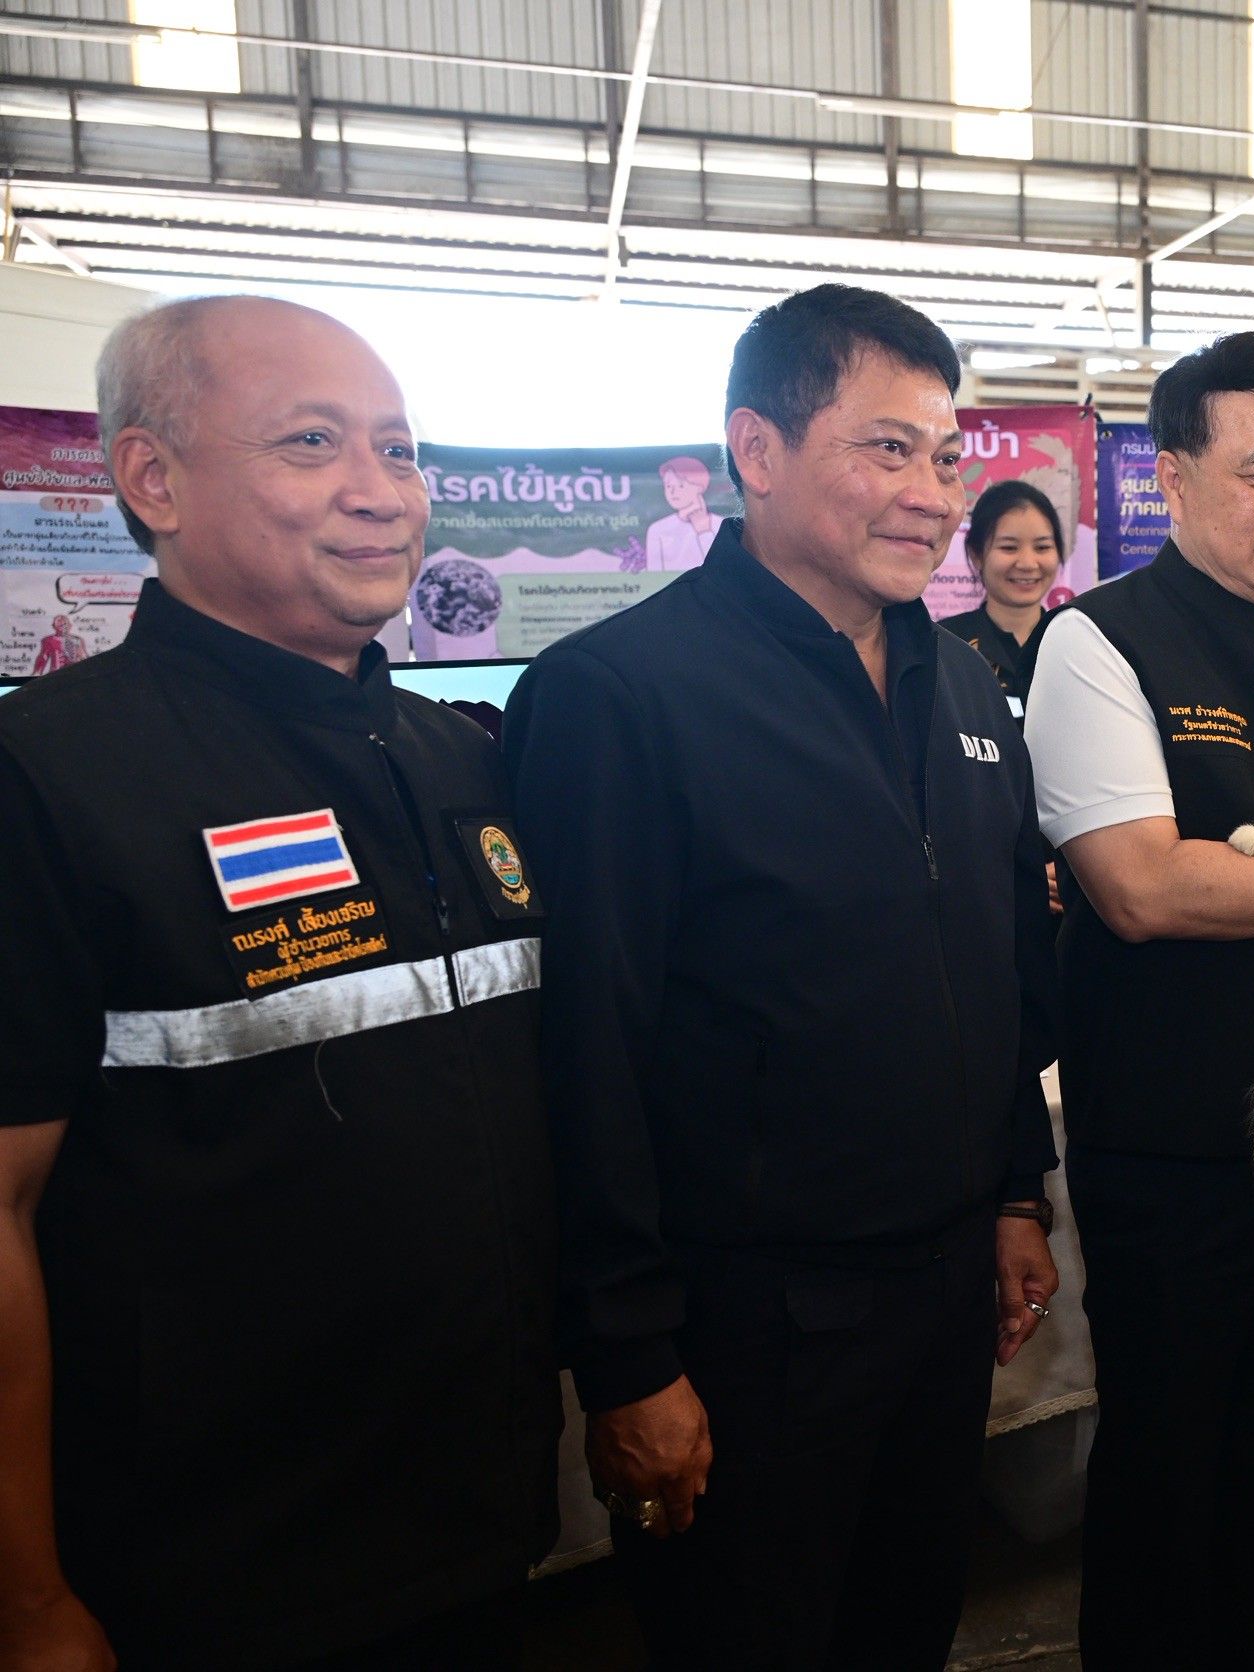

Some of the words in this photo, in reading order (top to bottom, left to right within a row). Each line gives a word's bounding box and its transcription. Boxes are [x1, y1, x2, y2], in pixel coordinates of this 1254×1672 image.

[421, 463, 631, 513] โรคไข้หูดับ
[959, 732, 1000, 763] DLD
[232, 917, 291, 952] ณรงค์
[277, 928, 351, 965] ผู้อำนวยการ
